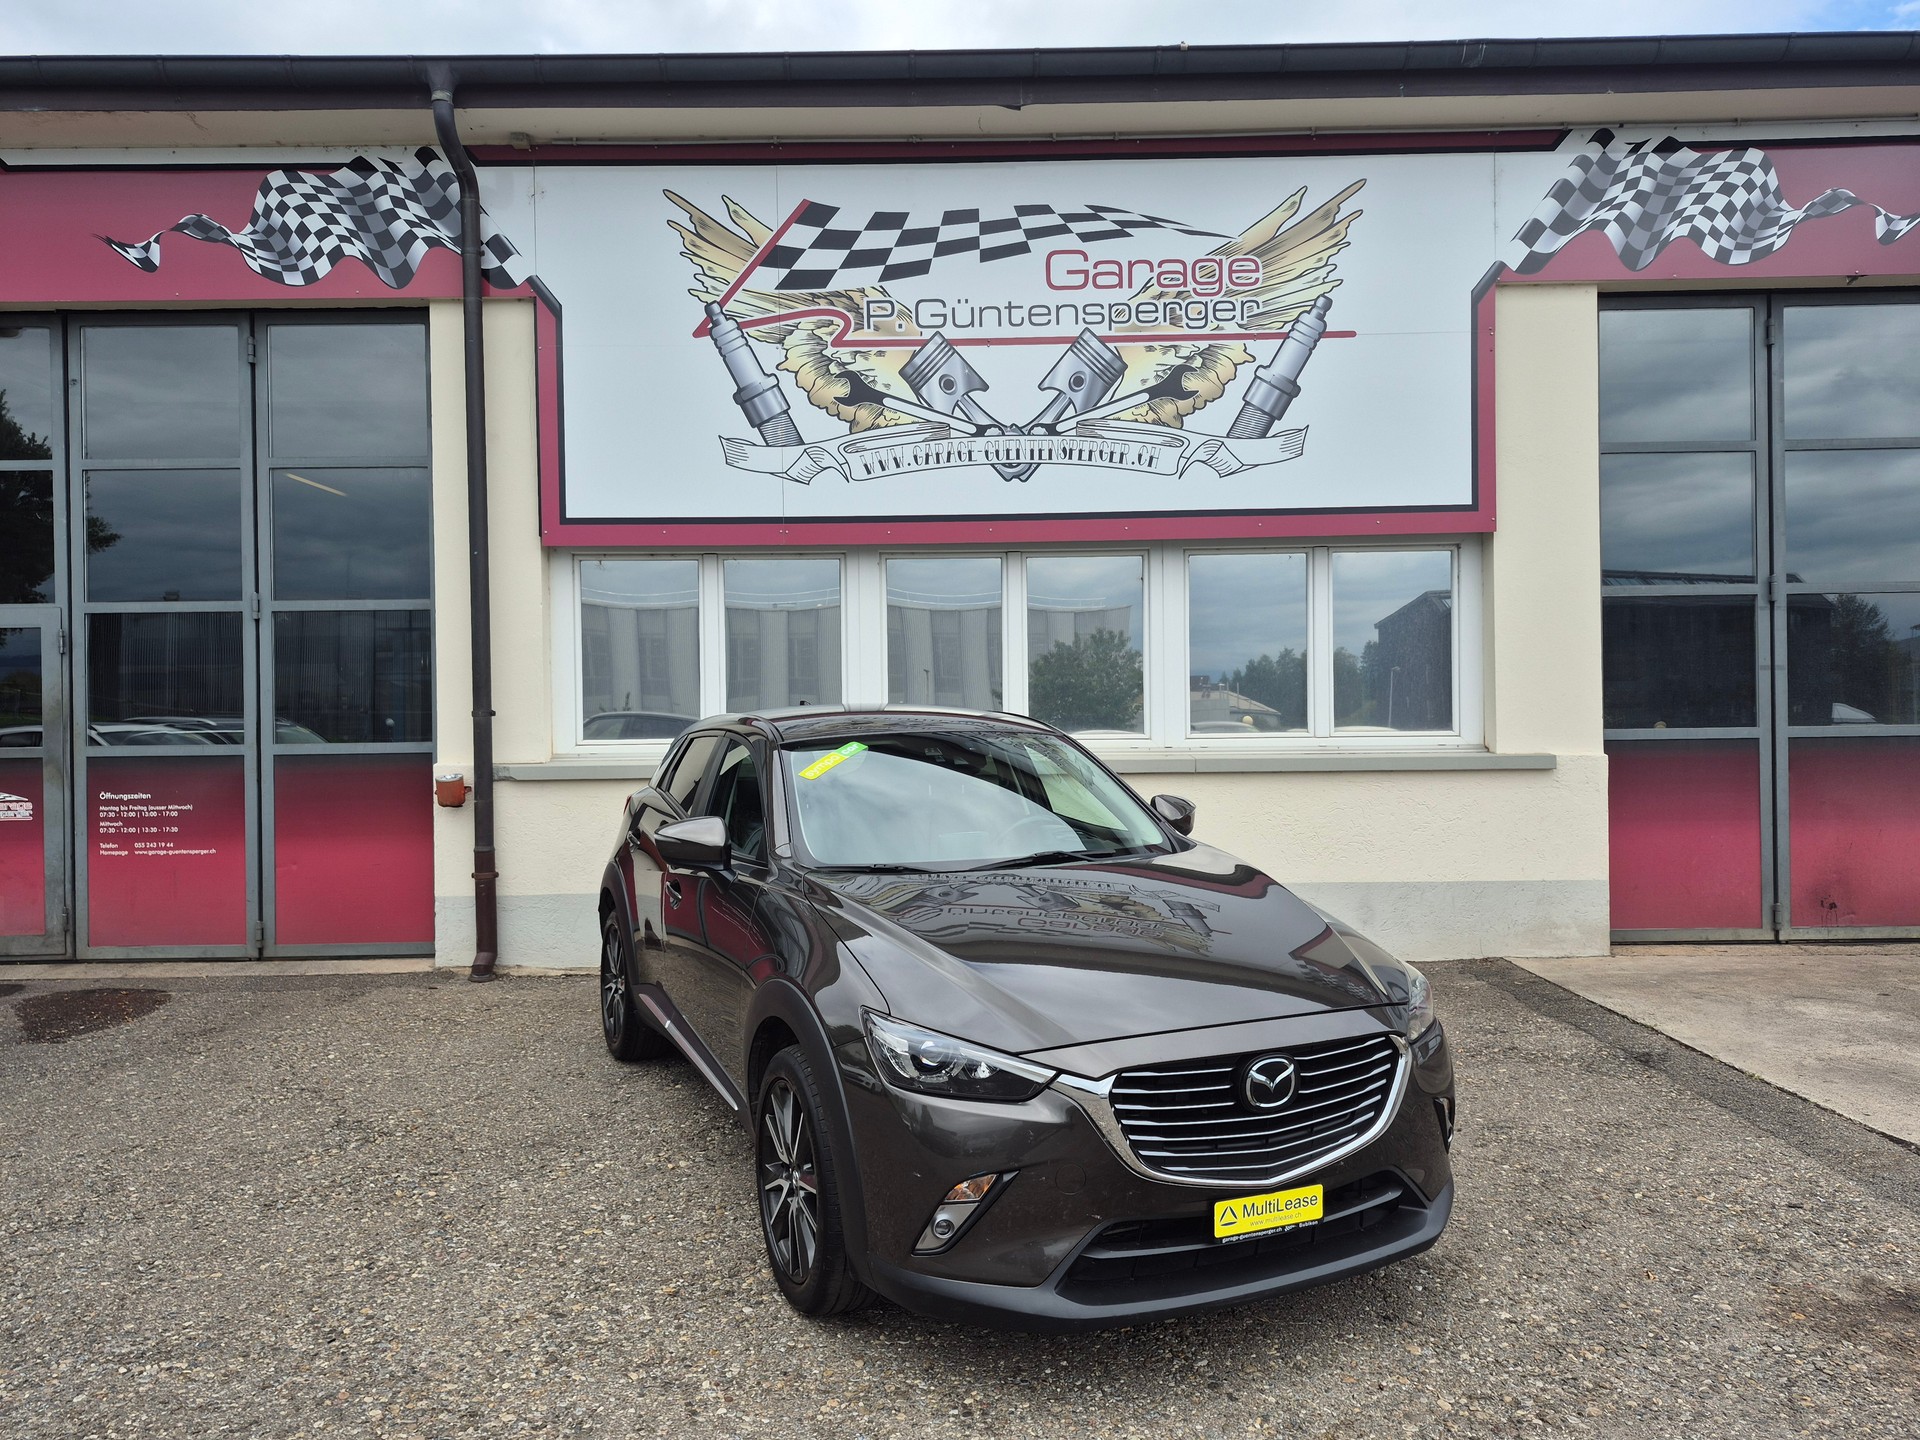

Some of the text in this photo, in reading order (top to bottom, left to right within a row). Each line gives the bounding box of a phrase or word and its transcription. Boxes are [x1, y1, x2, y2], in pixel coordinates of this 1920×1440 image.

[1045, 249, 1261, 297] Garage
[859, 438, 1162, 476] WWW.GARAGE-GUENTENSPERGER.CH
[841, 743, 859, 756] car
[99, 791, 152, 801] Öffnungszeiten
[129, 804, 147, 812] Freitag
[1242, 1194, 1318, 1219] MultiLease
